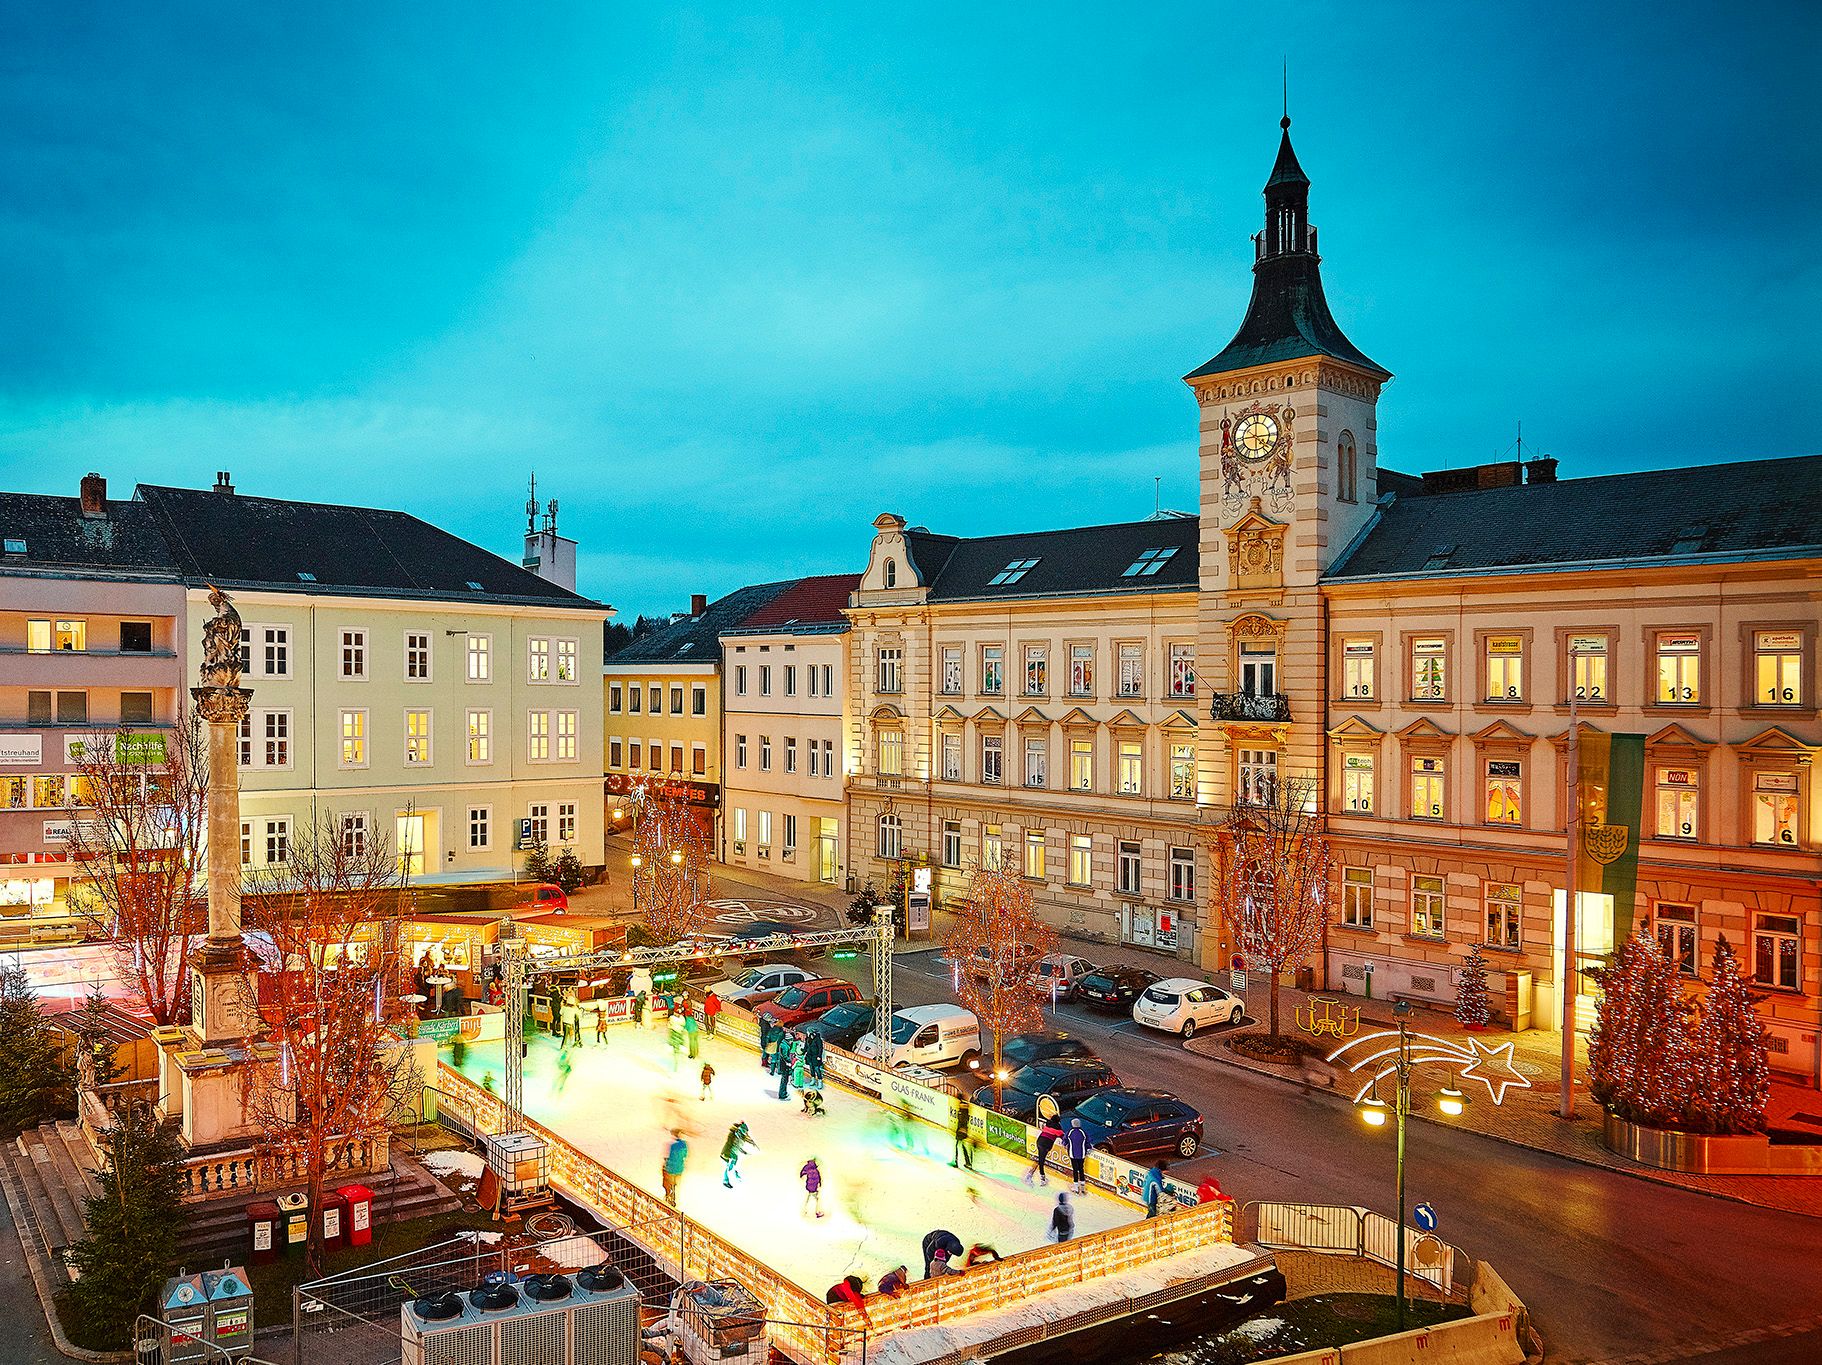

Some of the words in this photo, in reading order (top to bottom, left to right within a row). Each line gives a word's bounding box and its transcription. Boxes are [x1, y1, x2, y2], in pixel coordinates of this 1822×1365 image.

[1352, 685, 1369, 696] 18
[1433, 685, 1441, 696] 3
[1508, 686, 1517, 697] 8
[1576, 686, 1601, 698] 22
[1668, 687, 1692, 699] 13
[1768, 687, 1794, 701] 16
[1083, 778, 1089, 788] 2
[1669, 772, 1687, 782] NÖN
[1351, 798, 1369, 810] 10
[1432, 804, 1440, 815] 5
[1508, 810, 1516, 821] 1
[522, 819, 530, 832] P
[1682, 822, 1692, 835] 9
[1781, 829, 1792, 842] 6
[608, 1001, 625, 1014] NÖN
